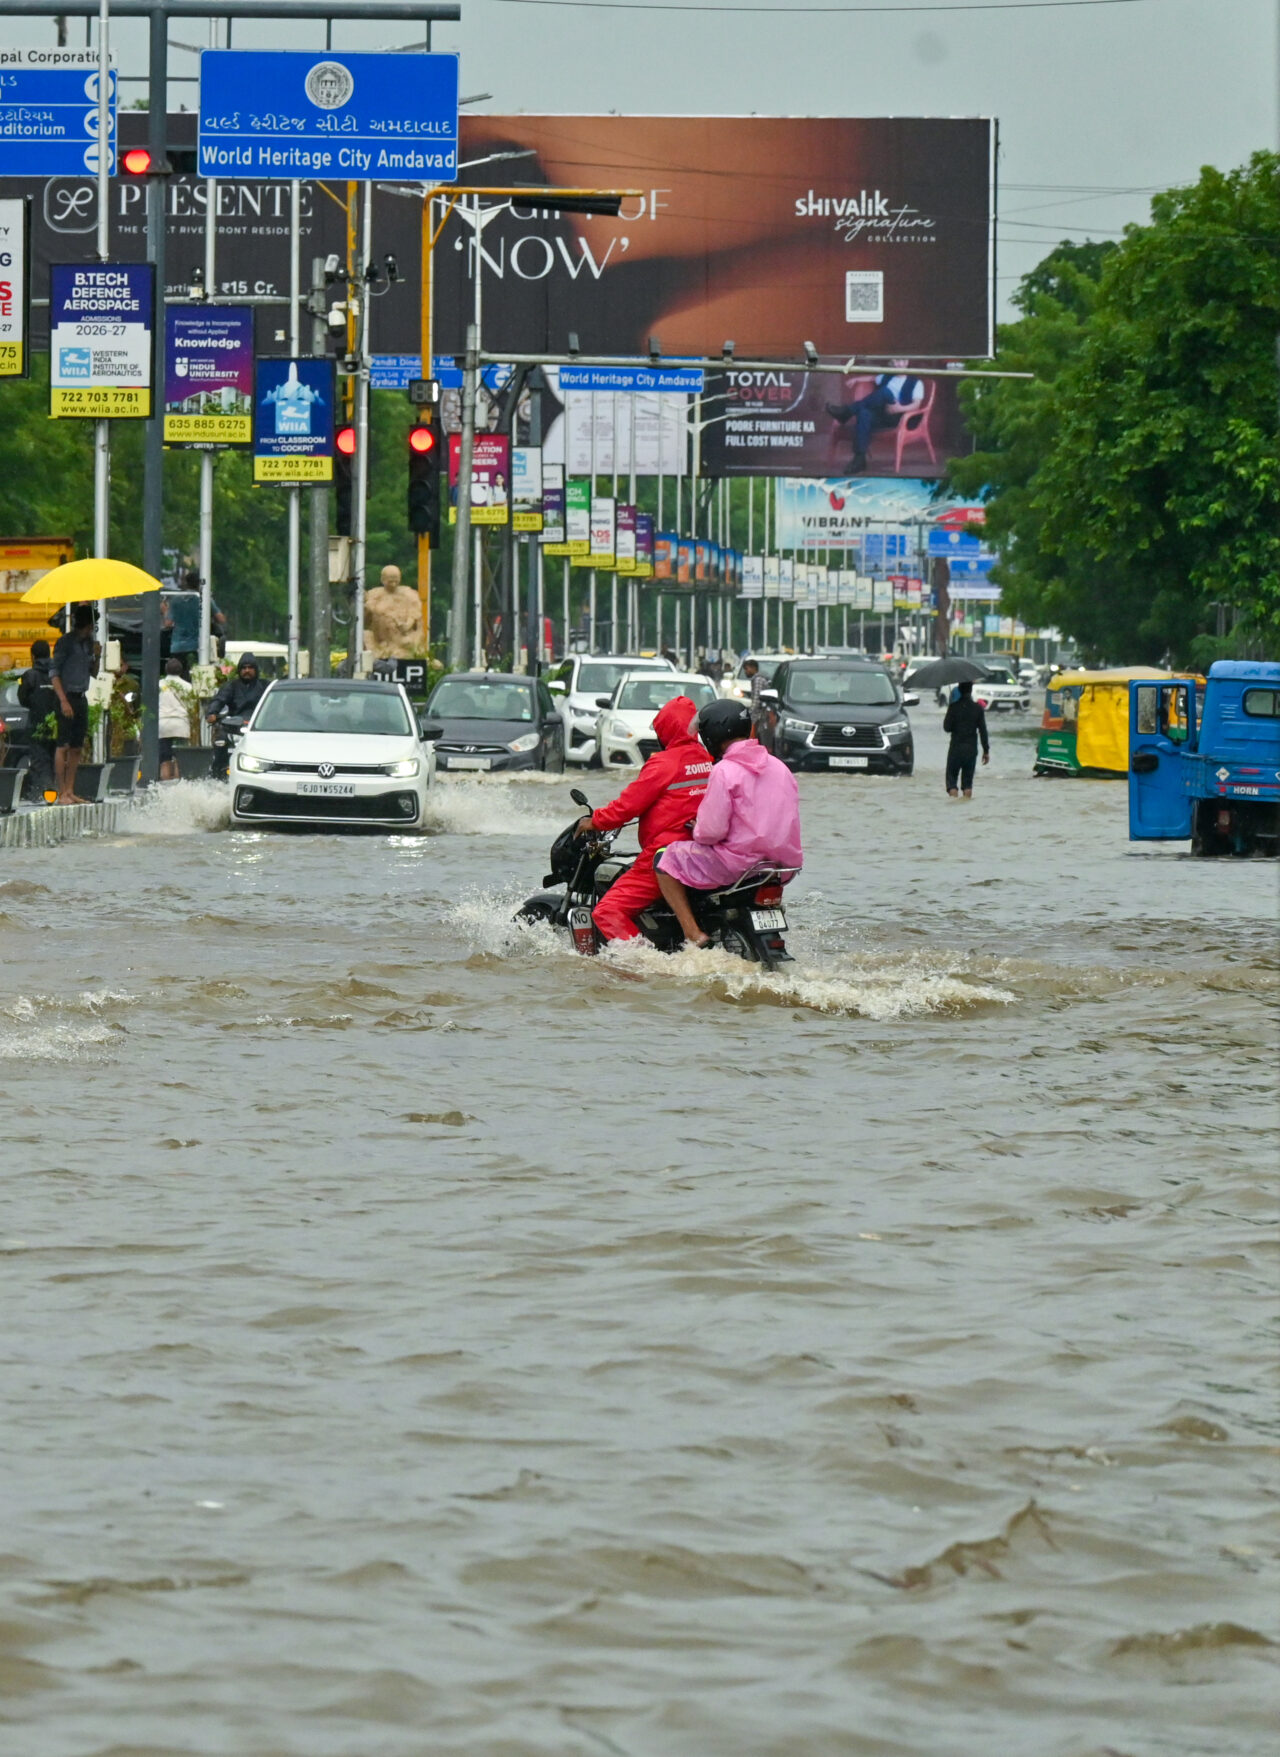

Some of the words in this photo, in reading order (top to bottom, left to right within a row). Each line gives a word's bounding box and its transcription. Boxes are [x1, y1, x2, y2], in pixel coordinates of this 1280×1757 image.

[316, 114, 358, 132] સીટી
[369, 120, 452, 134] અમદાવાદ
[202, 146, 252, 165] World
[259, 147, 332, 169] Heritage
[338, 148, 371, 170] City
[377, 149, 455, 168] Amdavad
[118, 177, 313, 217] PÉSENTÉ
[252, 226, 312, 234] RESIDECY
[75, 273, 128, 285] B.TECH
[222, 281, 247, 293] ₹15
[254, 281, 276, 294] Cr.
[72, 288, 130, 298] DEFENCE
[64, 300, 139, 310] AEROSPACE
[76, 325, 126, 335] 2026-27
[175, 338, 241, 349] Knowledge
[62, 367, 88, 375] WIIA
[560, 372, 588, 384] World
[592, 374, 633, 386] Heritage
[636, 374, 655, 387] City
[658, 375, 702, 387] Amdavad
[726, 372, 791, 386] TOTAL
[61, 393, 82, 401] 722
[87, 393, 108, 401] 703
[113, 393, 138, 401] 7781
[727, 387, 792, 400] COVER
[61, 404, 139, 413] www.wiia.ac.in
[169, 420, 190, 428] 635
[194, 420, 214, 428] 885
[218, 420, 246, 429] 6275
[279, 422, 307, 431] WIIA
[726, 421, 753, 431] POORE
[755, 421, 801, 432] FURNITURE
[803, 421, 815, 432] KA
[726, 436, 745, 446] FULL
[747, 436, 768, 446] COST
[770, 436, 803, 446] WAPAS!
[803, 517, 871, 528] VIBRANT
[1234, 786, 1258, 795] HORN
